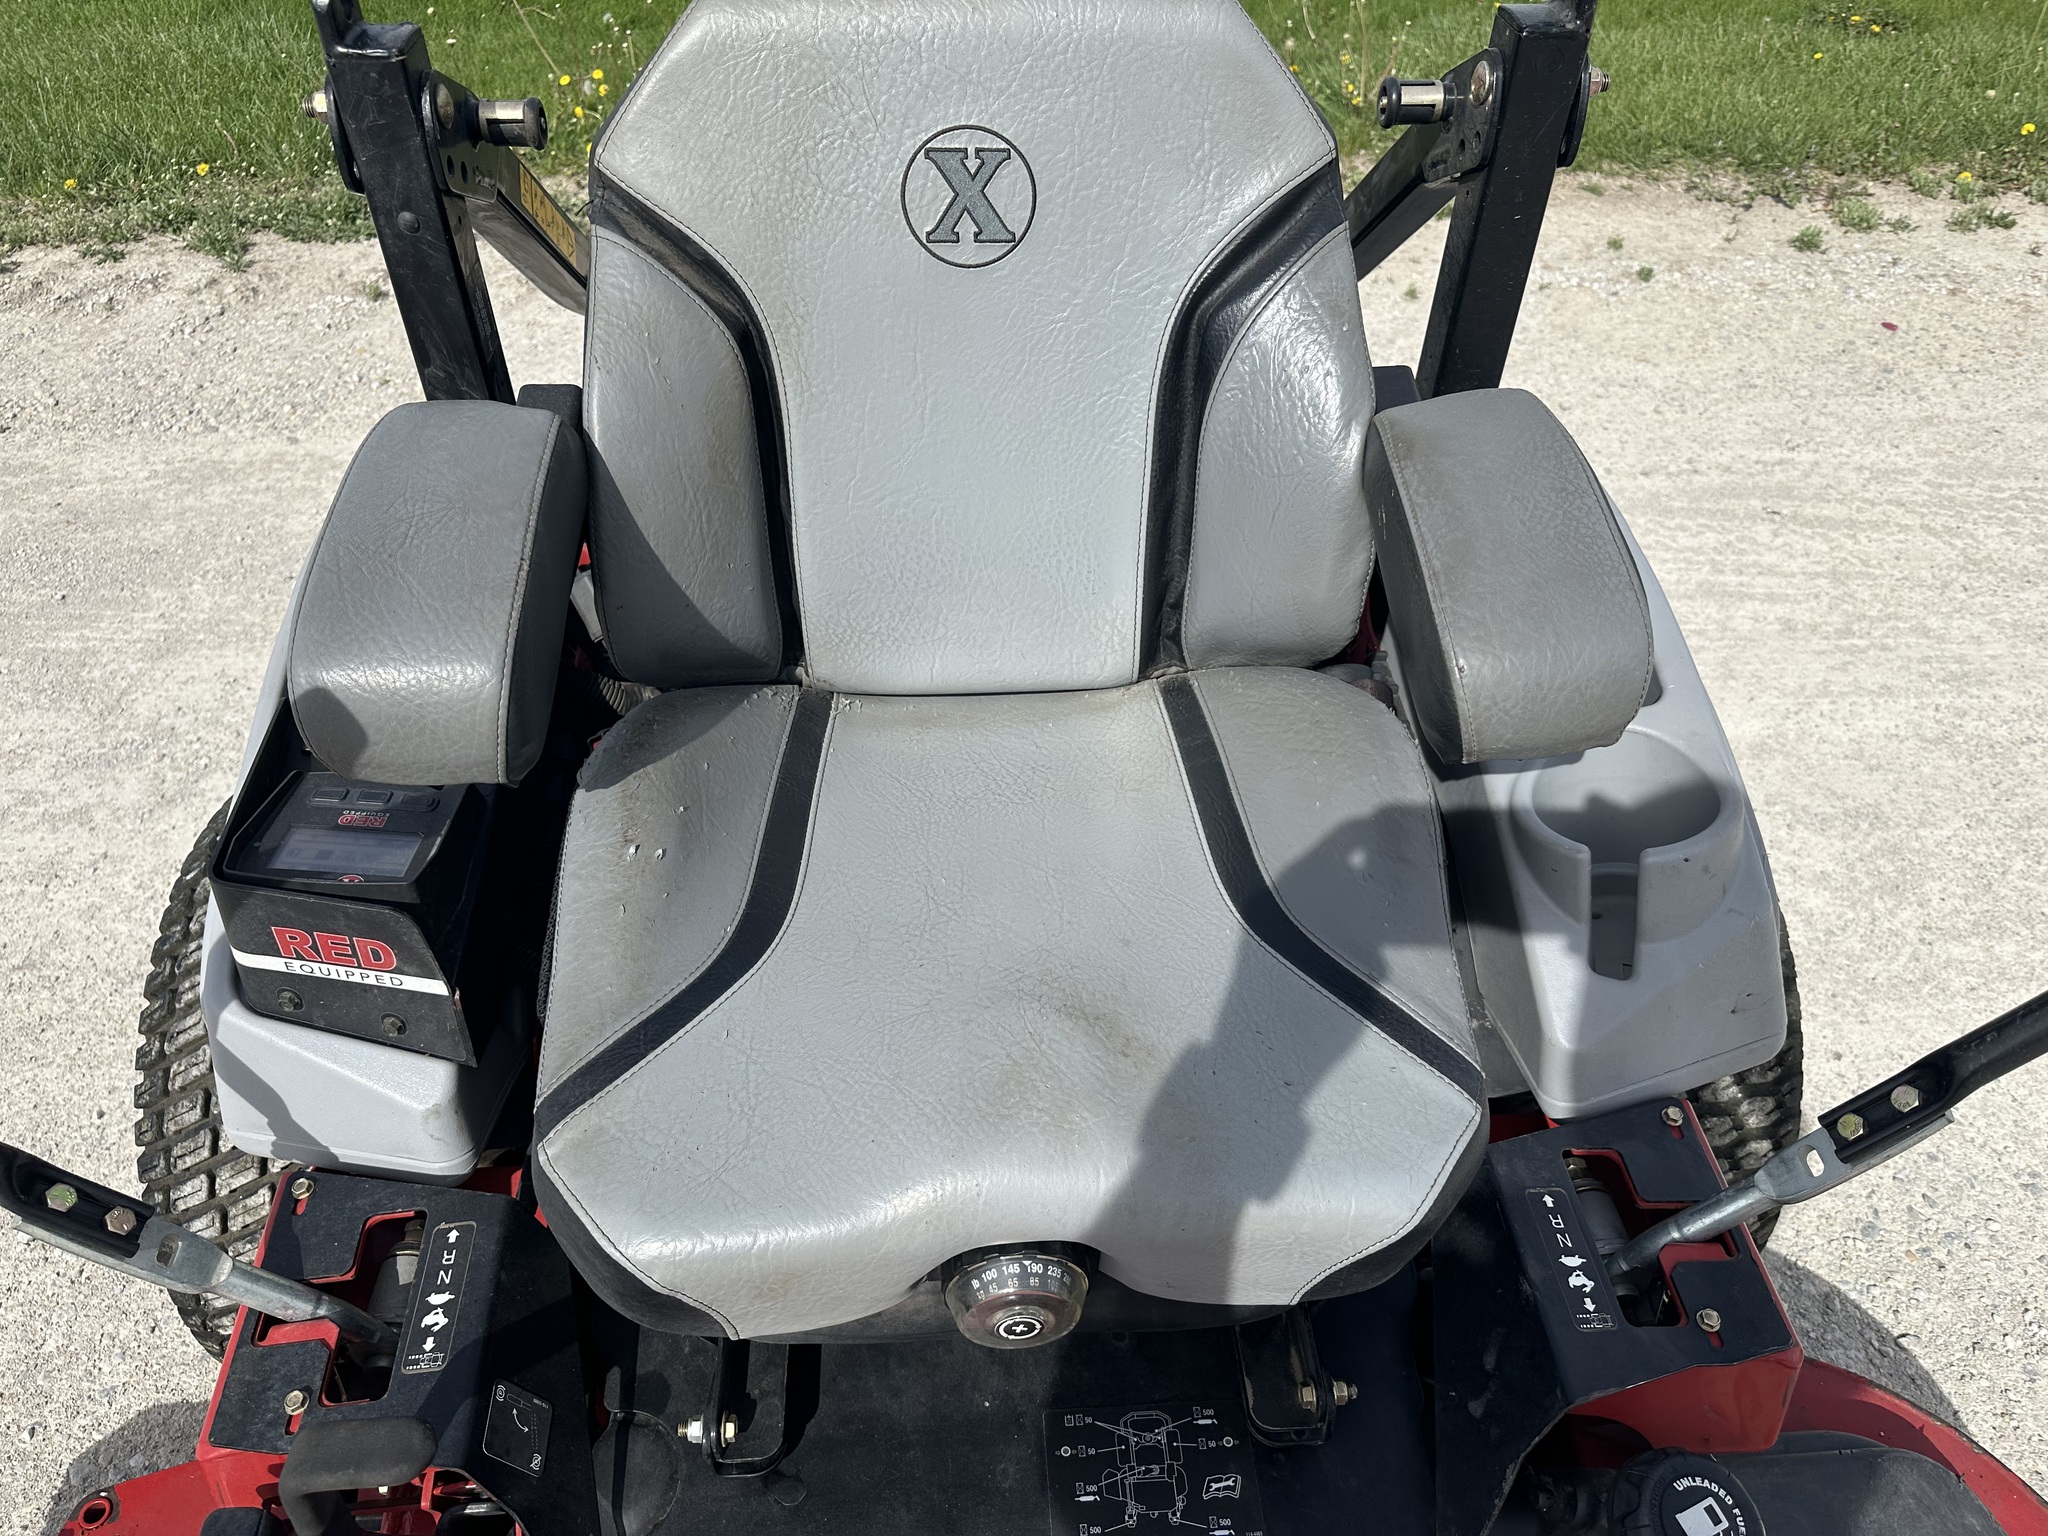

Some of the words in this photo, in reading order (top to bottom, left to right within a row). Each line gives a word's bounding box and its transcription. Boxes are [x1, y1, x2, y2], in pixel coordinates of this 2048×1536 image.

[924, 147, 1016, 243] X
[343, 809, 390, 817] EQUIPPED
[338, 814, 388, 828] RED
[271, 926, 397, 971] RED
[283, 961, 404, 987] EQUIPPED
[1548, 1214, 1565, 1228] R
[1556, 1233, 1573, 1248] N
[441, 1249, 456, 1265] R
[437, 1269, 452, 1285] N
[981, 1268, 998, 1282] 100
[1002, 1263, 1020, 1275] 145
[1027, 1263, 1043, 1273] 190
[1047, 1266, 1062, 1278] 235
[989, 1282, 998, 1293] 45
[1007, 1277, 1019, 1288] 65
[1029, 1277, 1040, 1287] 85
[1202, 1408, 1214, 1416] 500
[1085, 1416, 1093, 1424] 50
[1207, 1440, 1216, 1448] 50
[1673, 1477, 1733, 1505] UNLEADED
[1732, 1508, 1746, 1536] FUE
[1219, 1518, 1231, 1526] 500
[1090, 1526, 1102, 1534] 500
